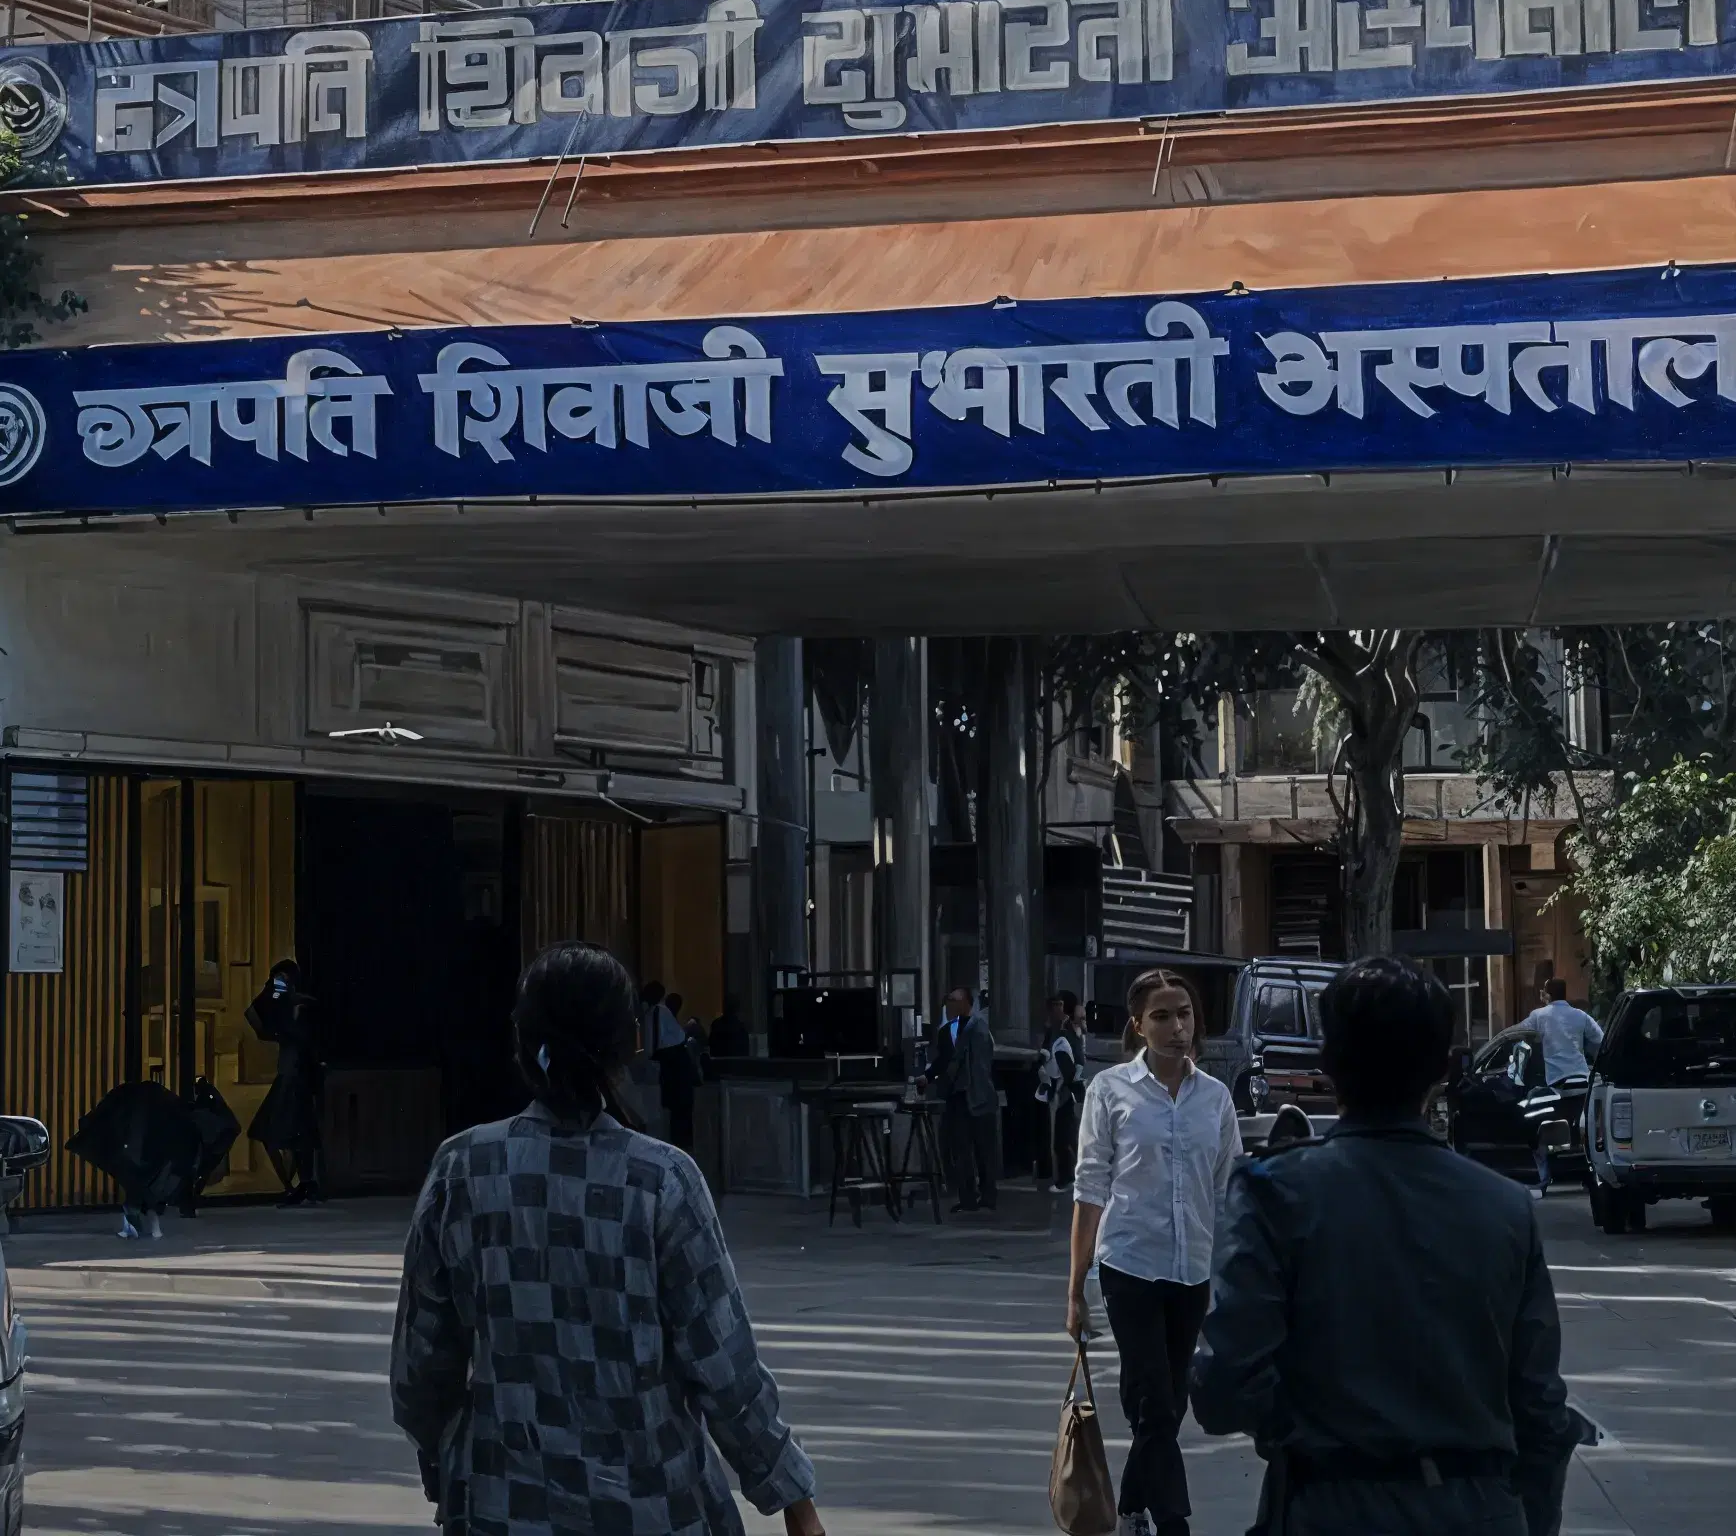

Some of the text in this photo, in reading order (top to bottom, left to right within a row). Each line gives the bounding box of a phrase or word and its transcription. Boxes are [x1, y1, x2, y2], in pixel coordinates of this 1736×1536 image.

[73, 348, 395, 468] छत्रपति
[417, 325, 785, 464] शिवाजी
[813, 300, 1230, 477] सुभारती
